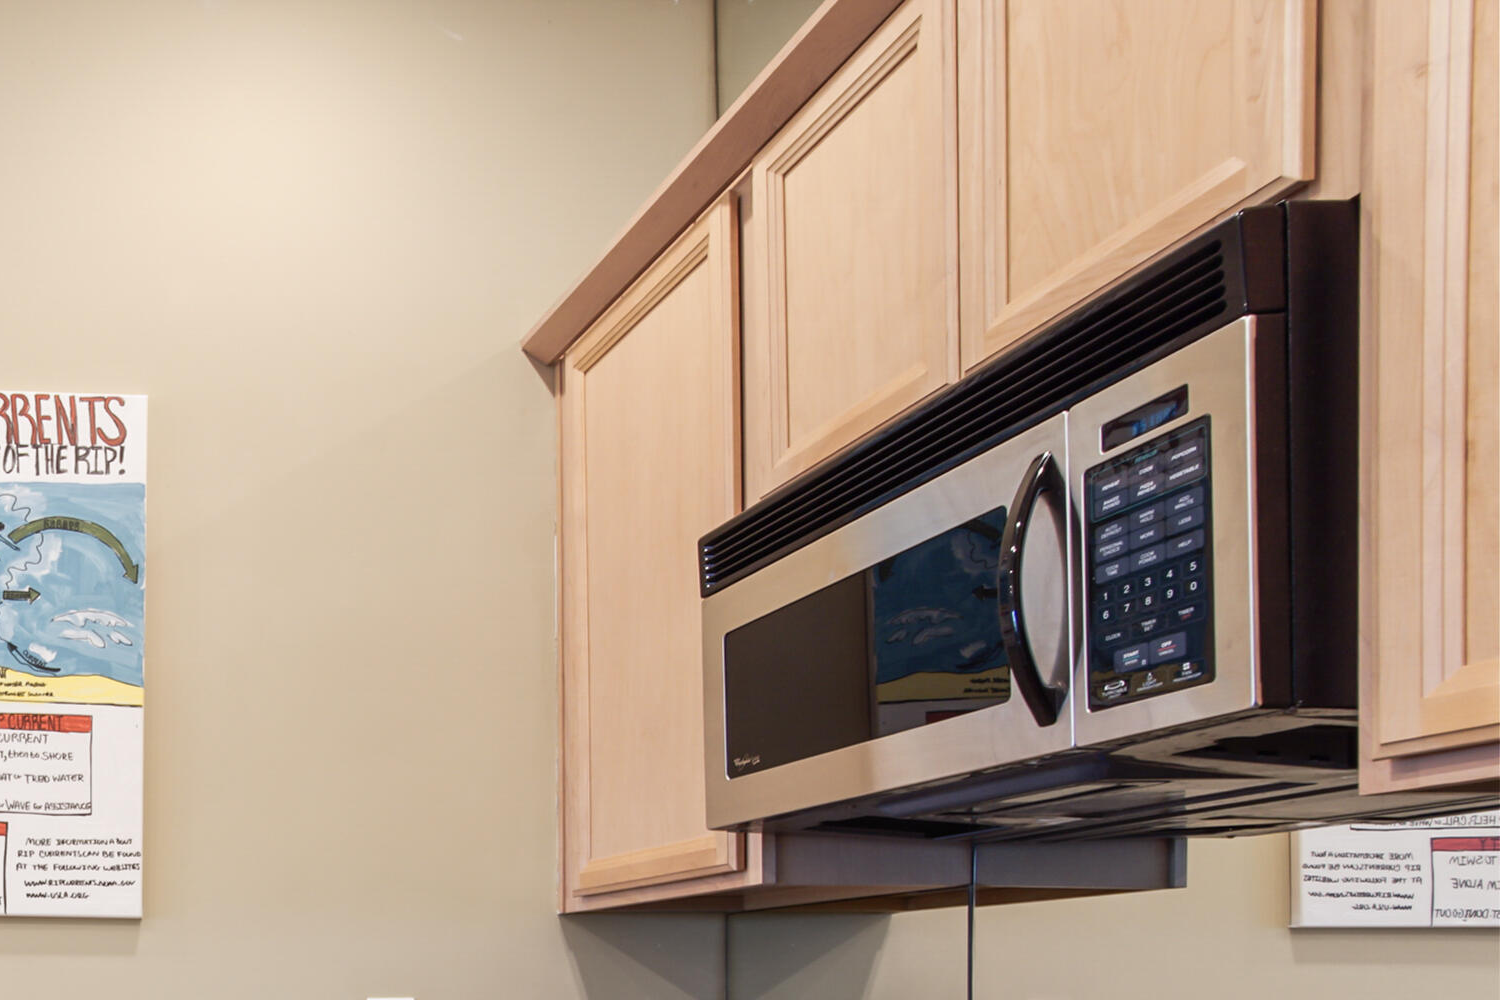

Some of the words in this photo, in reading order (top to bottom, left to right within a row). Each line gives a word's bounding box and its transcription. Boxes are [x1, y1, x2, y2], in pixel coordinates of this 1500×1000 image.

[3, 443, 29, 474] OF
[32, 443, 68, 476] THE
[74, 446, 126, 475] RIP!
[1104, 592, 1108, 600] 1
[1124, 585, 1130, 594] 2
[1144, 577, 1151, 586] 3
[1166, 569, 1173, 578] 4
[1190, 561, 1197, 571] 5
[1102, 610, 1109, 619] 6
[1124, 603, 1130, 612] 7
[1145, 596, 1152, 605] 8
[1166, 589, 1173, 598] 9
[1190, 581, 1197, 591] 0
[8, 714, 63, 731] CURRENT
[8, 749, 29, 759] then
[30, 750, 40, 759] to
[41, 751, 73, 760] SHORE
[52, 774, 84, 782] WATER
[5, 800, 30, 810] WAVE
[25, 837, 51, 846] MORE
[102, 850, 114, 858] BE
